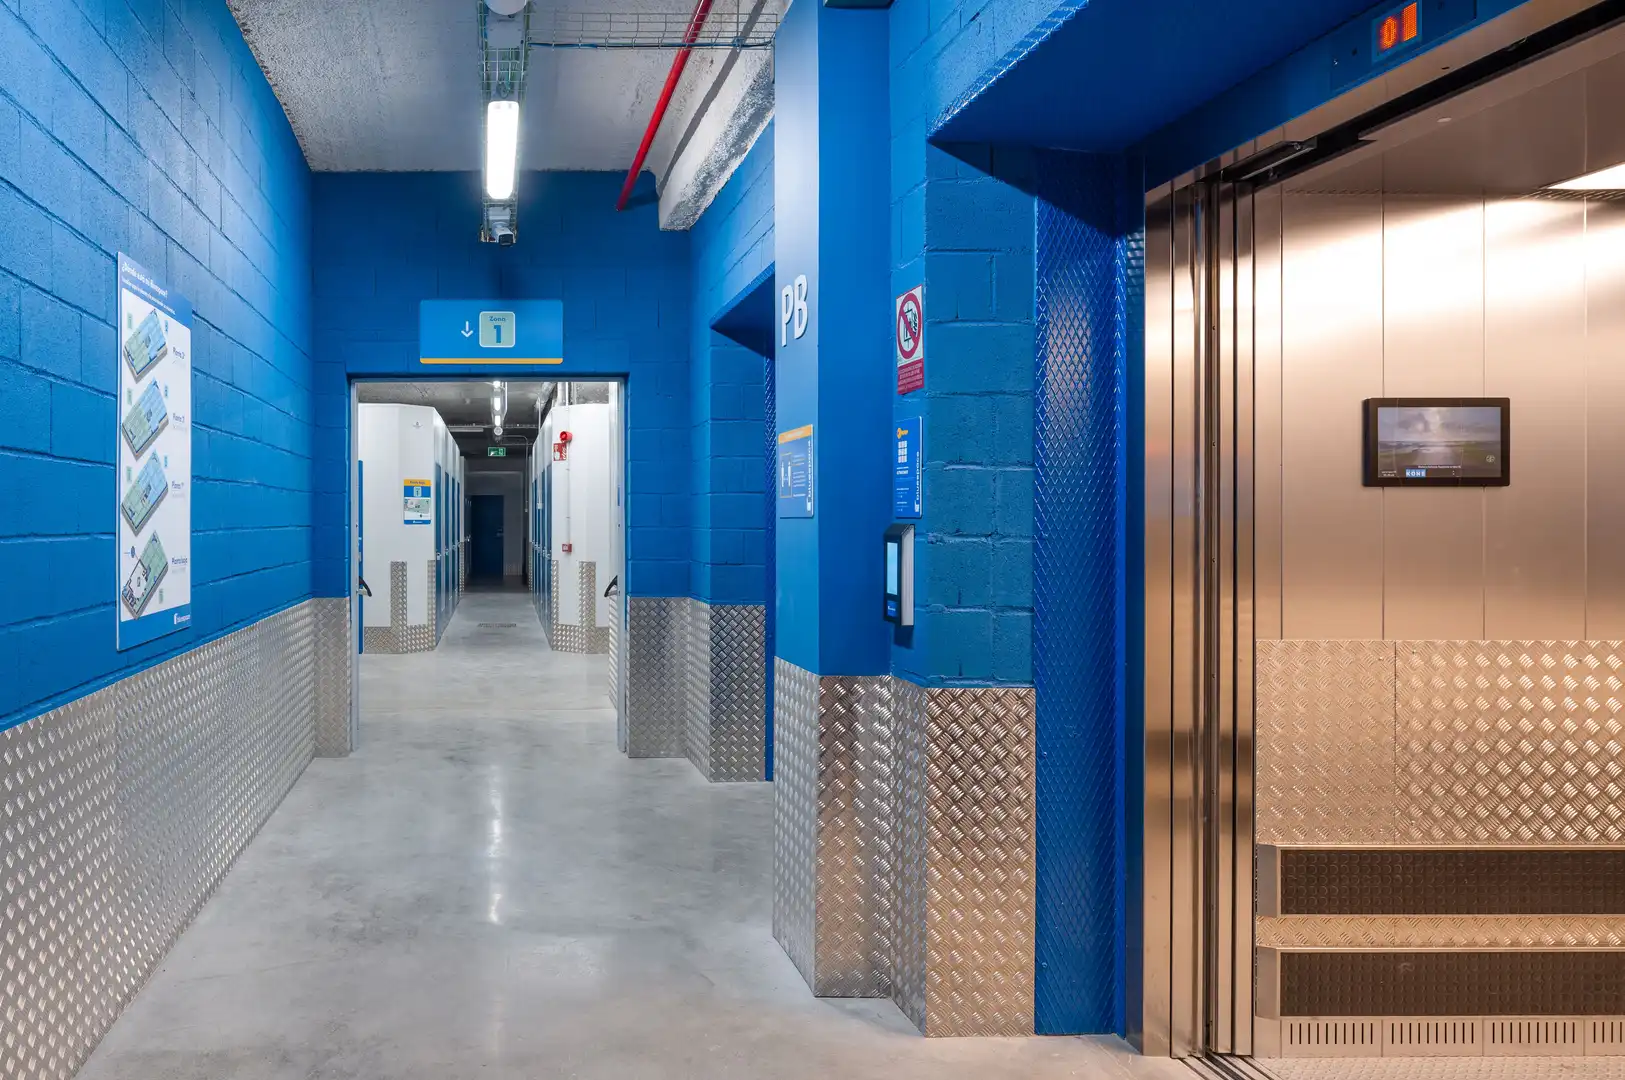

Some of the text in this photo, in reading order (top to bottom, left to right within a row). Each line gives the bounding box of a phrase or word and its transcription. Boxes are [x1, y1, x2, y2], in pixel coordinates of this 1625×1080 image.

[1380, 2, 1417, 50] 01
[493, 324, 502, 344] 1
[781, 274, 809, 347] PB
